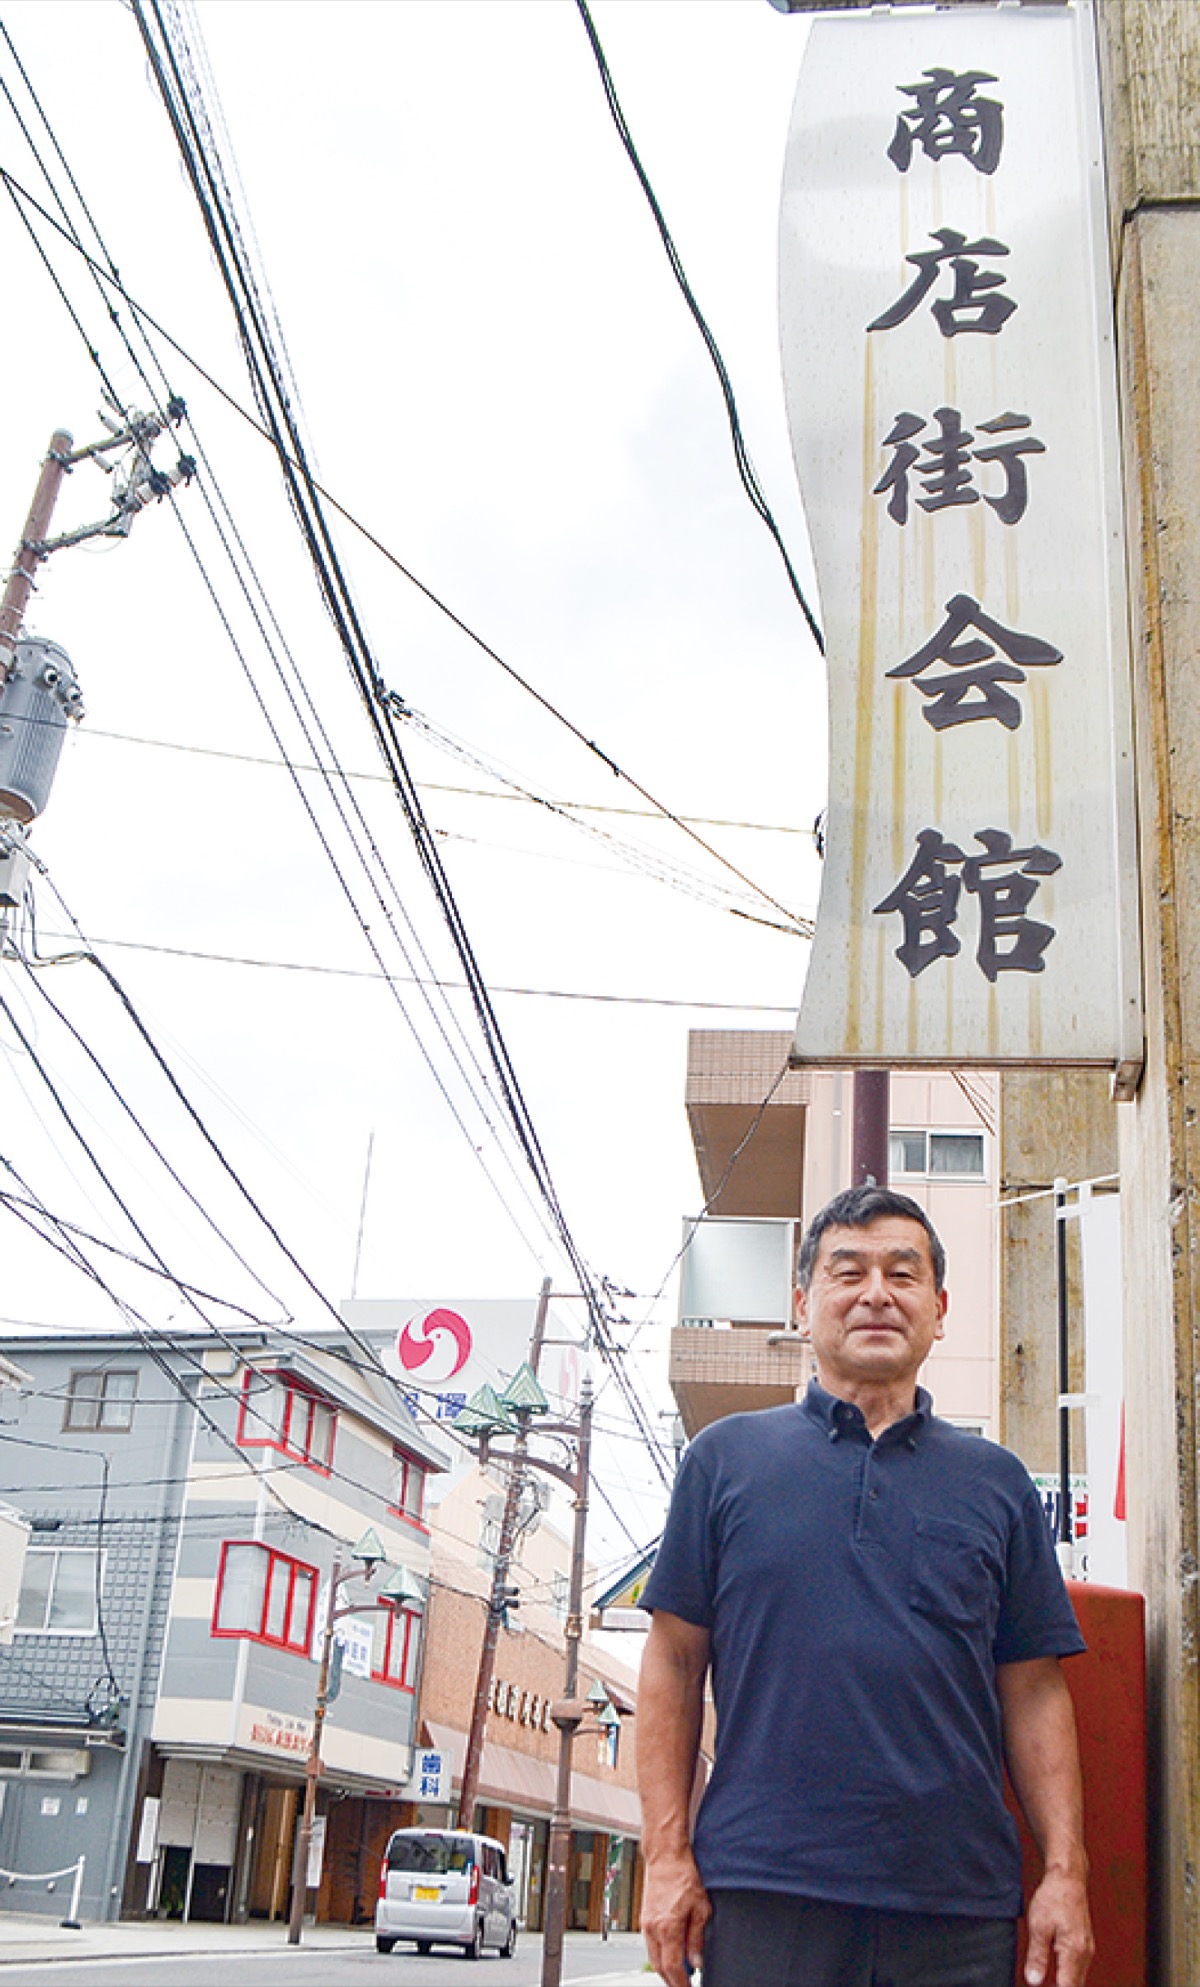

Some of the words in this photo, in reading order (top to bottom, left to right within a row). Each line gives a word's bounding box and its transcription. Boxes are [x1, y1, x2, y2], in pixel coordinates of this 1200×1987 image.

[867, 67, 1064, 983] 商店街会館
[420, 1753, 441, 1797] 歯科
